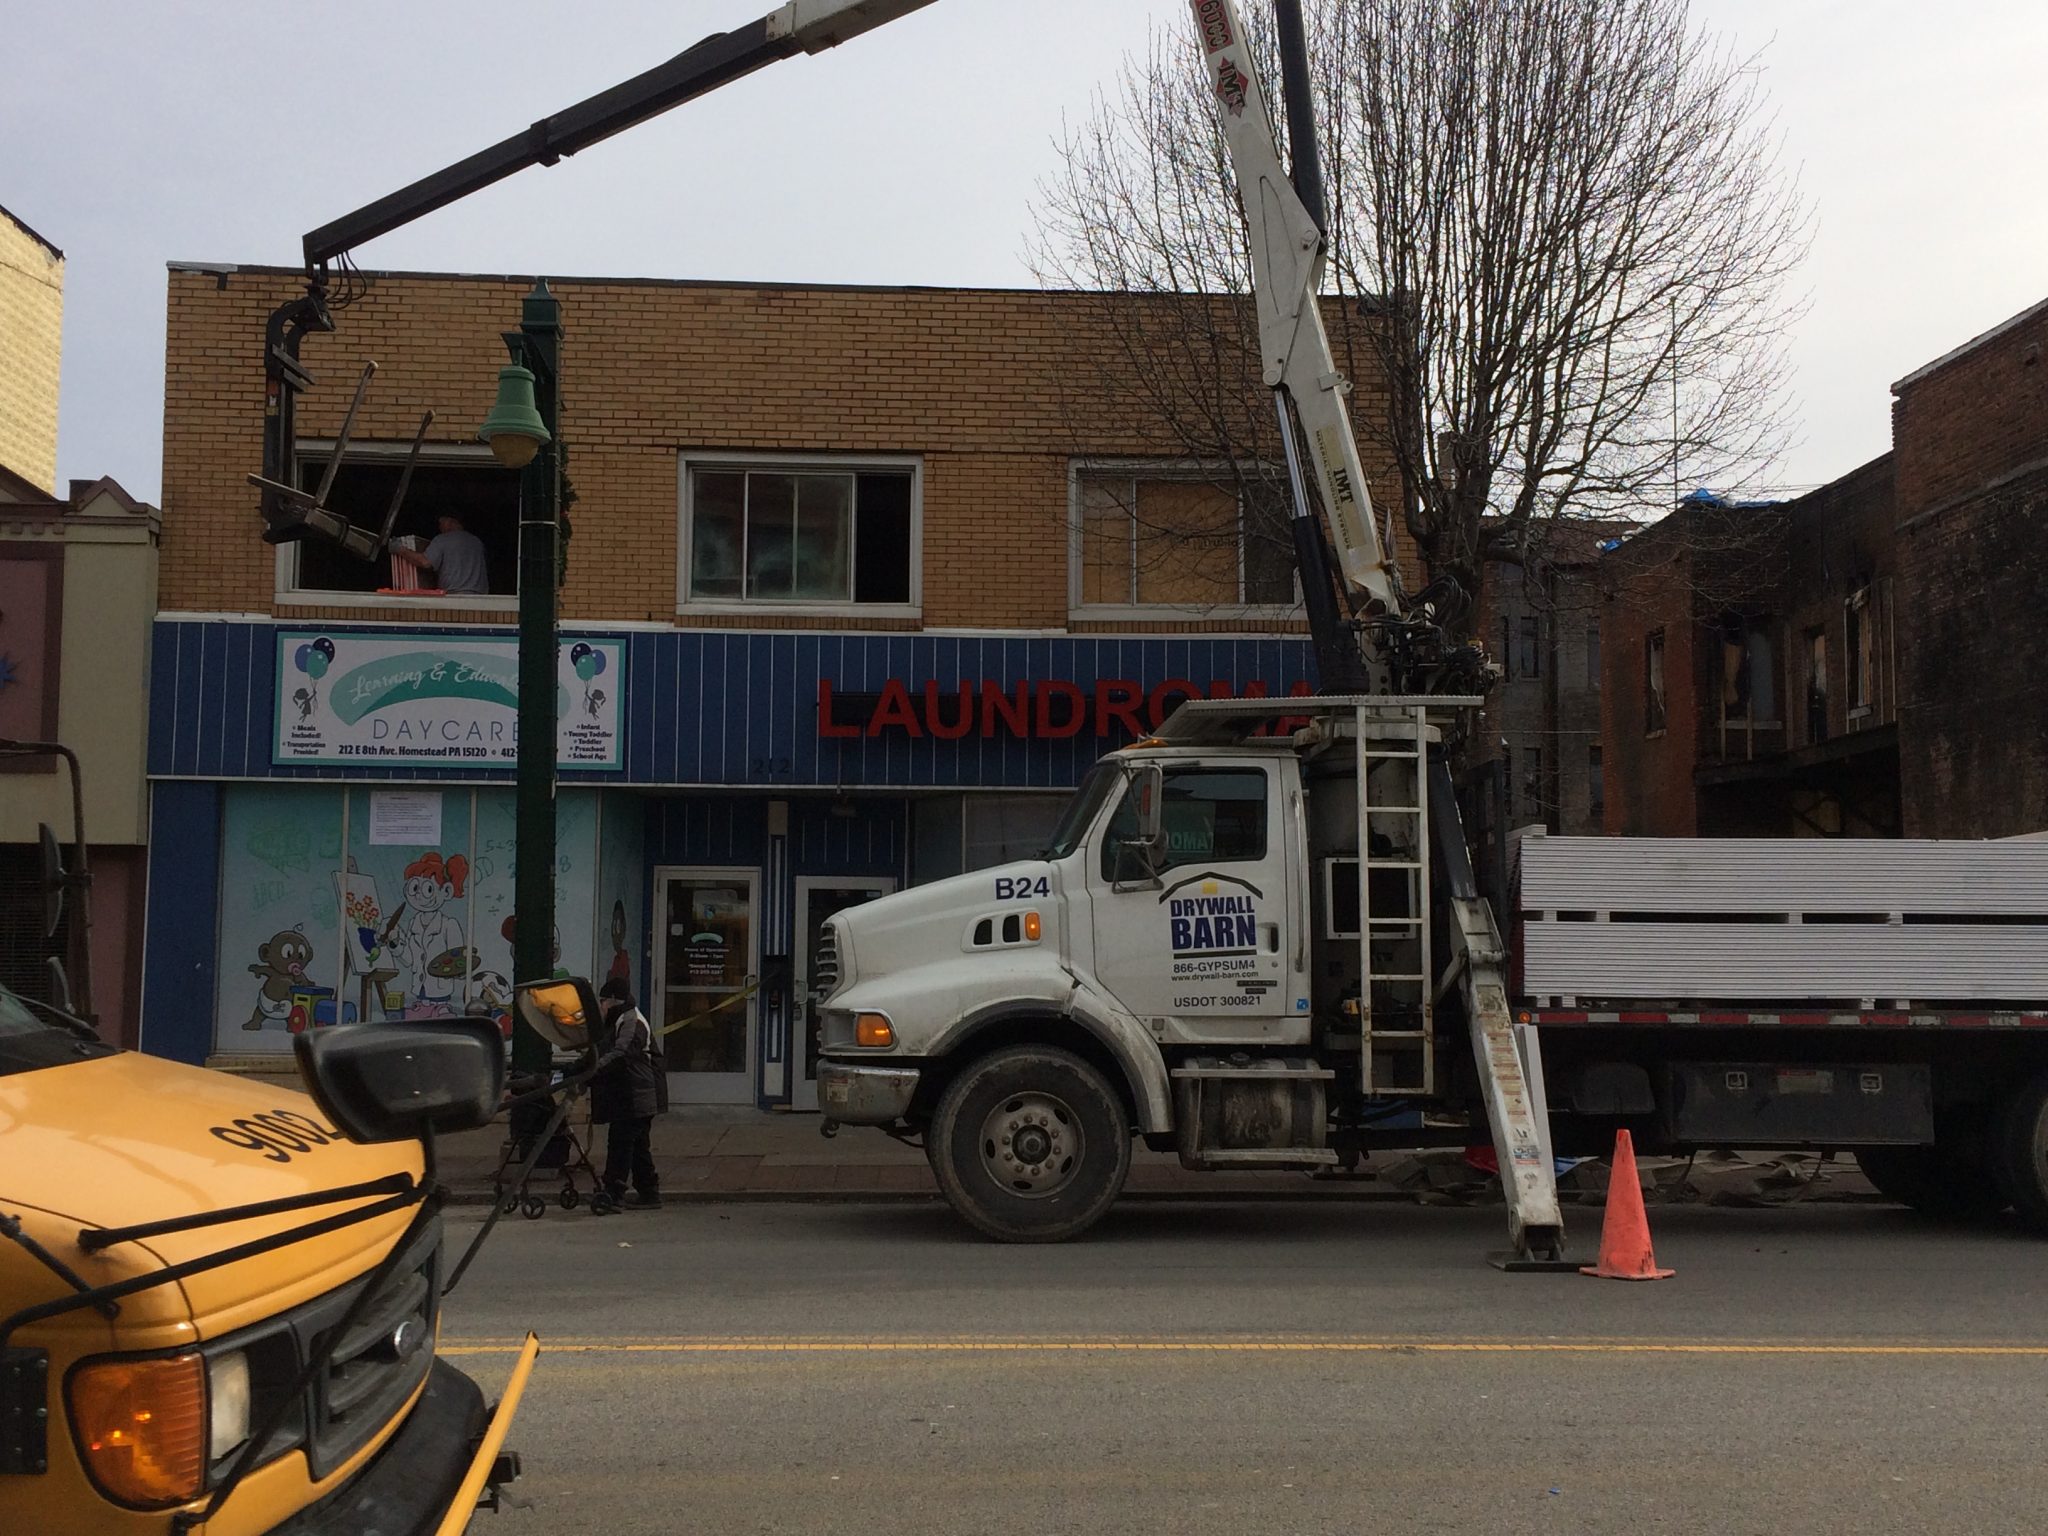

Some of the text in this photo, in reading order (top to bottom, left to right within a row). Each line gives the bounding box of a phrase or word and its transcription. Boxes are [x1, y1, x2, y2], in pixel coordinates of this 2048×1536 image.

[1218, 60, 1247, 112] IMT
[1333, 466, 1355, 504] IMT
[348, 670, 425, 705] Learning
[338, 744, 354, 755] 212
[355, 745, 361, 755] E
[362, 745, 378, 756] 8th
[379, 746, 397, 756] Ave.
[398, 746, 447, 757] Homestead
[448, 746, 461, 757] PA
[462, 747, 487, 757] 15120
[995, 876, 1050, 900] B24
[1170, 895, 1255, 918] DRYWALL
[1170, 914, 1257, 951] BARN
[1171, 970, 1259, 982] www.drywall-barn.com
[1173, 959, 1256, 974] 866-GYPSUM4
[1174, 995, 1261, 1008] USDOT 300821
[209, 1109, 338, 1163] 9002
